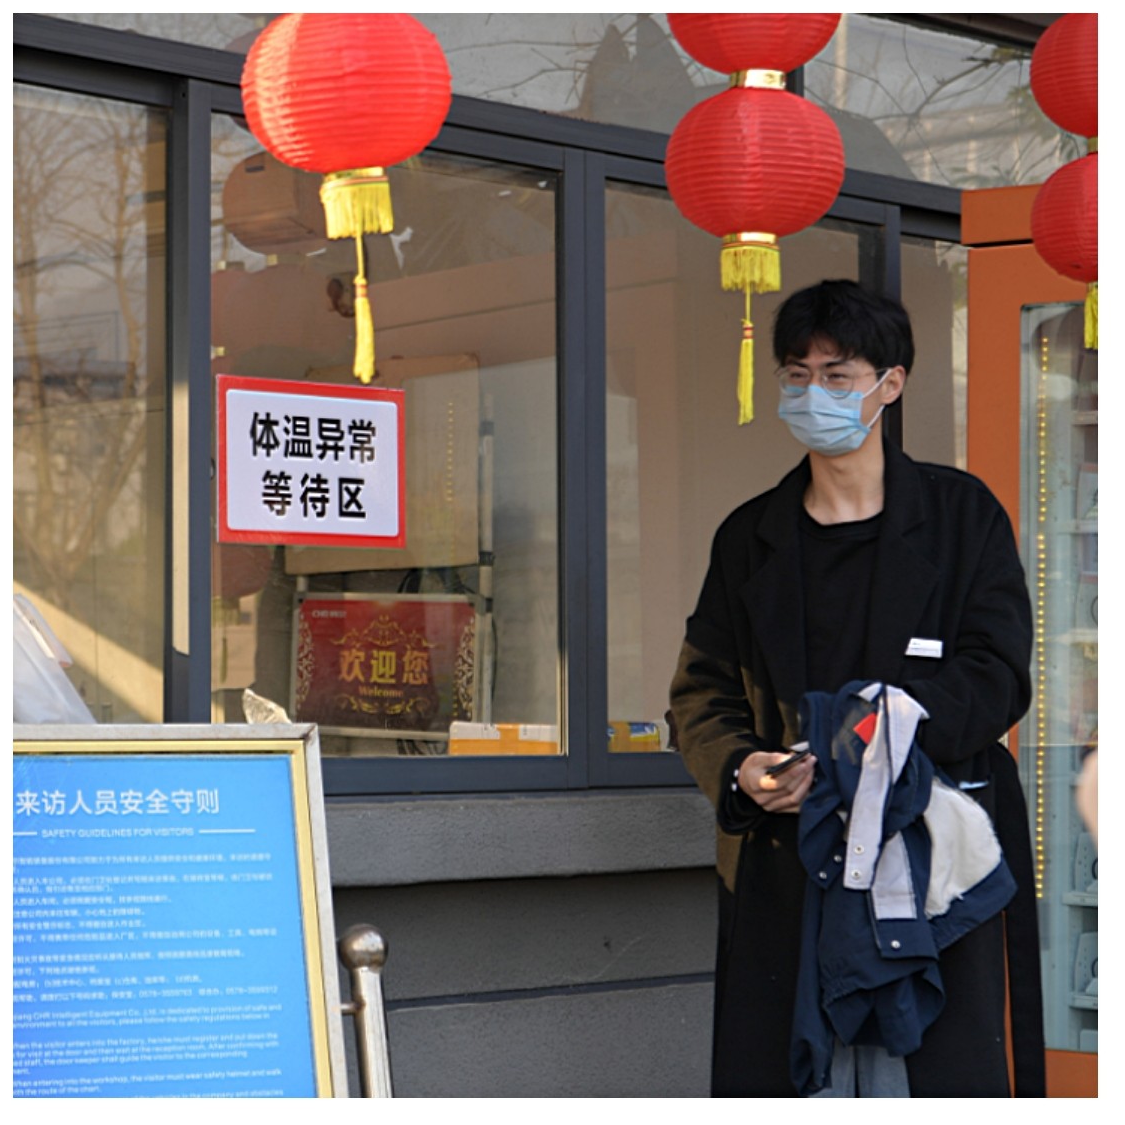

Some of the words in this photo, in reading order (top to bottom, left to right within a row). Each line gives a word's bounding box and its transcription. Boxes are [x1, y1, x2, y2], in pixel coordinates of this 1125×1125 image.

[250, 412, 376, 463] 体温异常
[262, 470, 367, 519] 等待区
[339, 644, 430, 685] 欢迎您
[359, 685, 404, 697] Welcome
[16, 788, 220, 816] 来访人员安全守则
[42, 829, 75, 837] SAFETY
[77, 828, 131, 837] GUIDELINES
[133, 828, 152, 836] FOR
[154, 828, 193, 836] VISITORS
